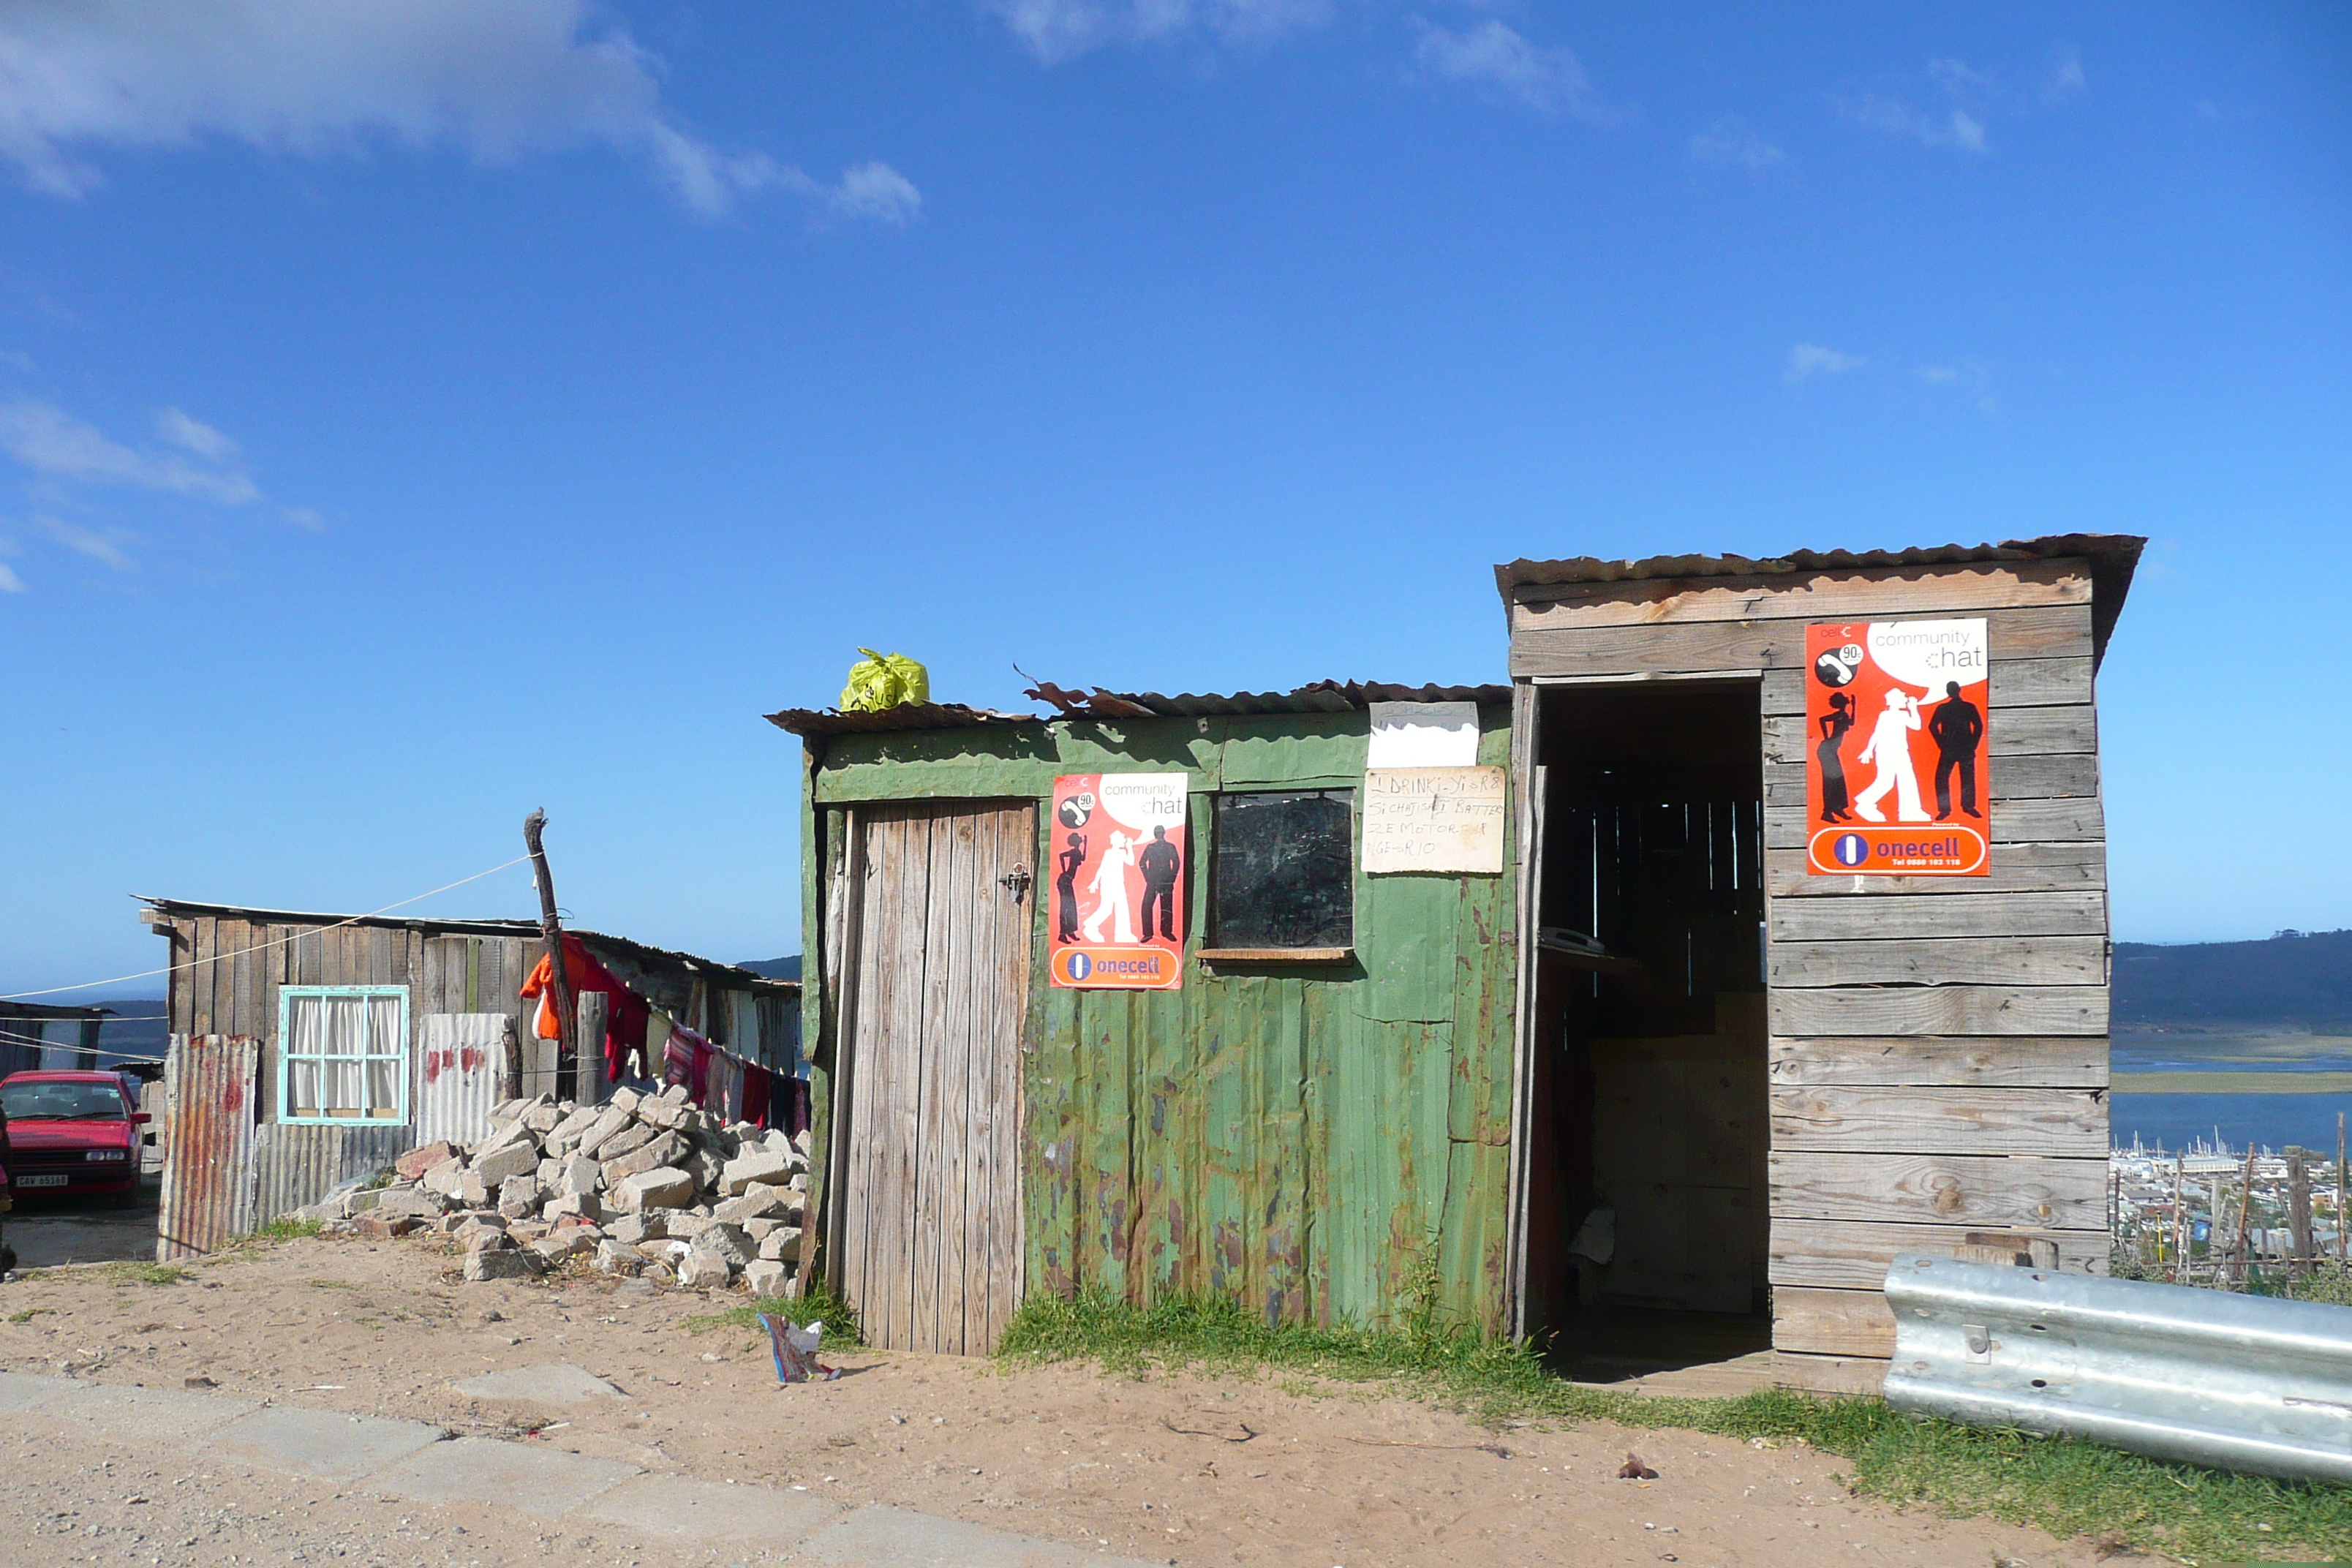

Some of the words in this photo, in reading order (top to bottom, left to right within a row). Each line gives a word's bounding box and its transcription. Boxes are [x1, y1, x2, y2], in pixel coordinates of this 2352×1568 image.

[1876, 630, 1970, 647] community
[1926, 647, 1982, 668] chat
[1105, 784, 1175, 796] community
[1141, 797, 1183, 814] chat
[1877, 837, 1959, 856] onecell
[1097, 957, 1160, 973] onecell
